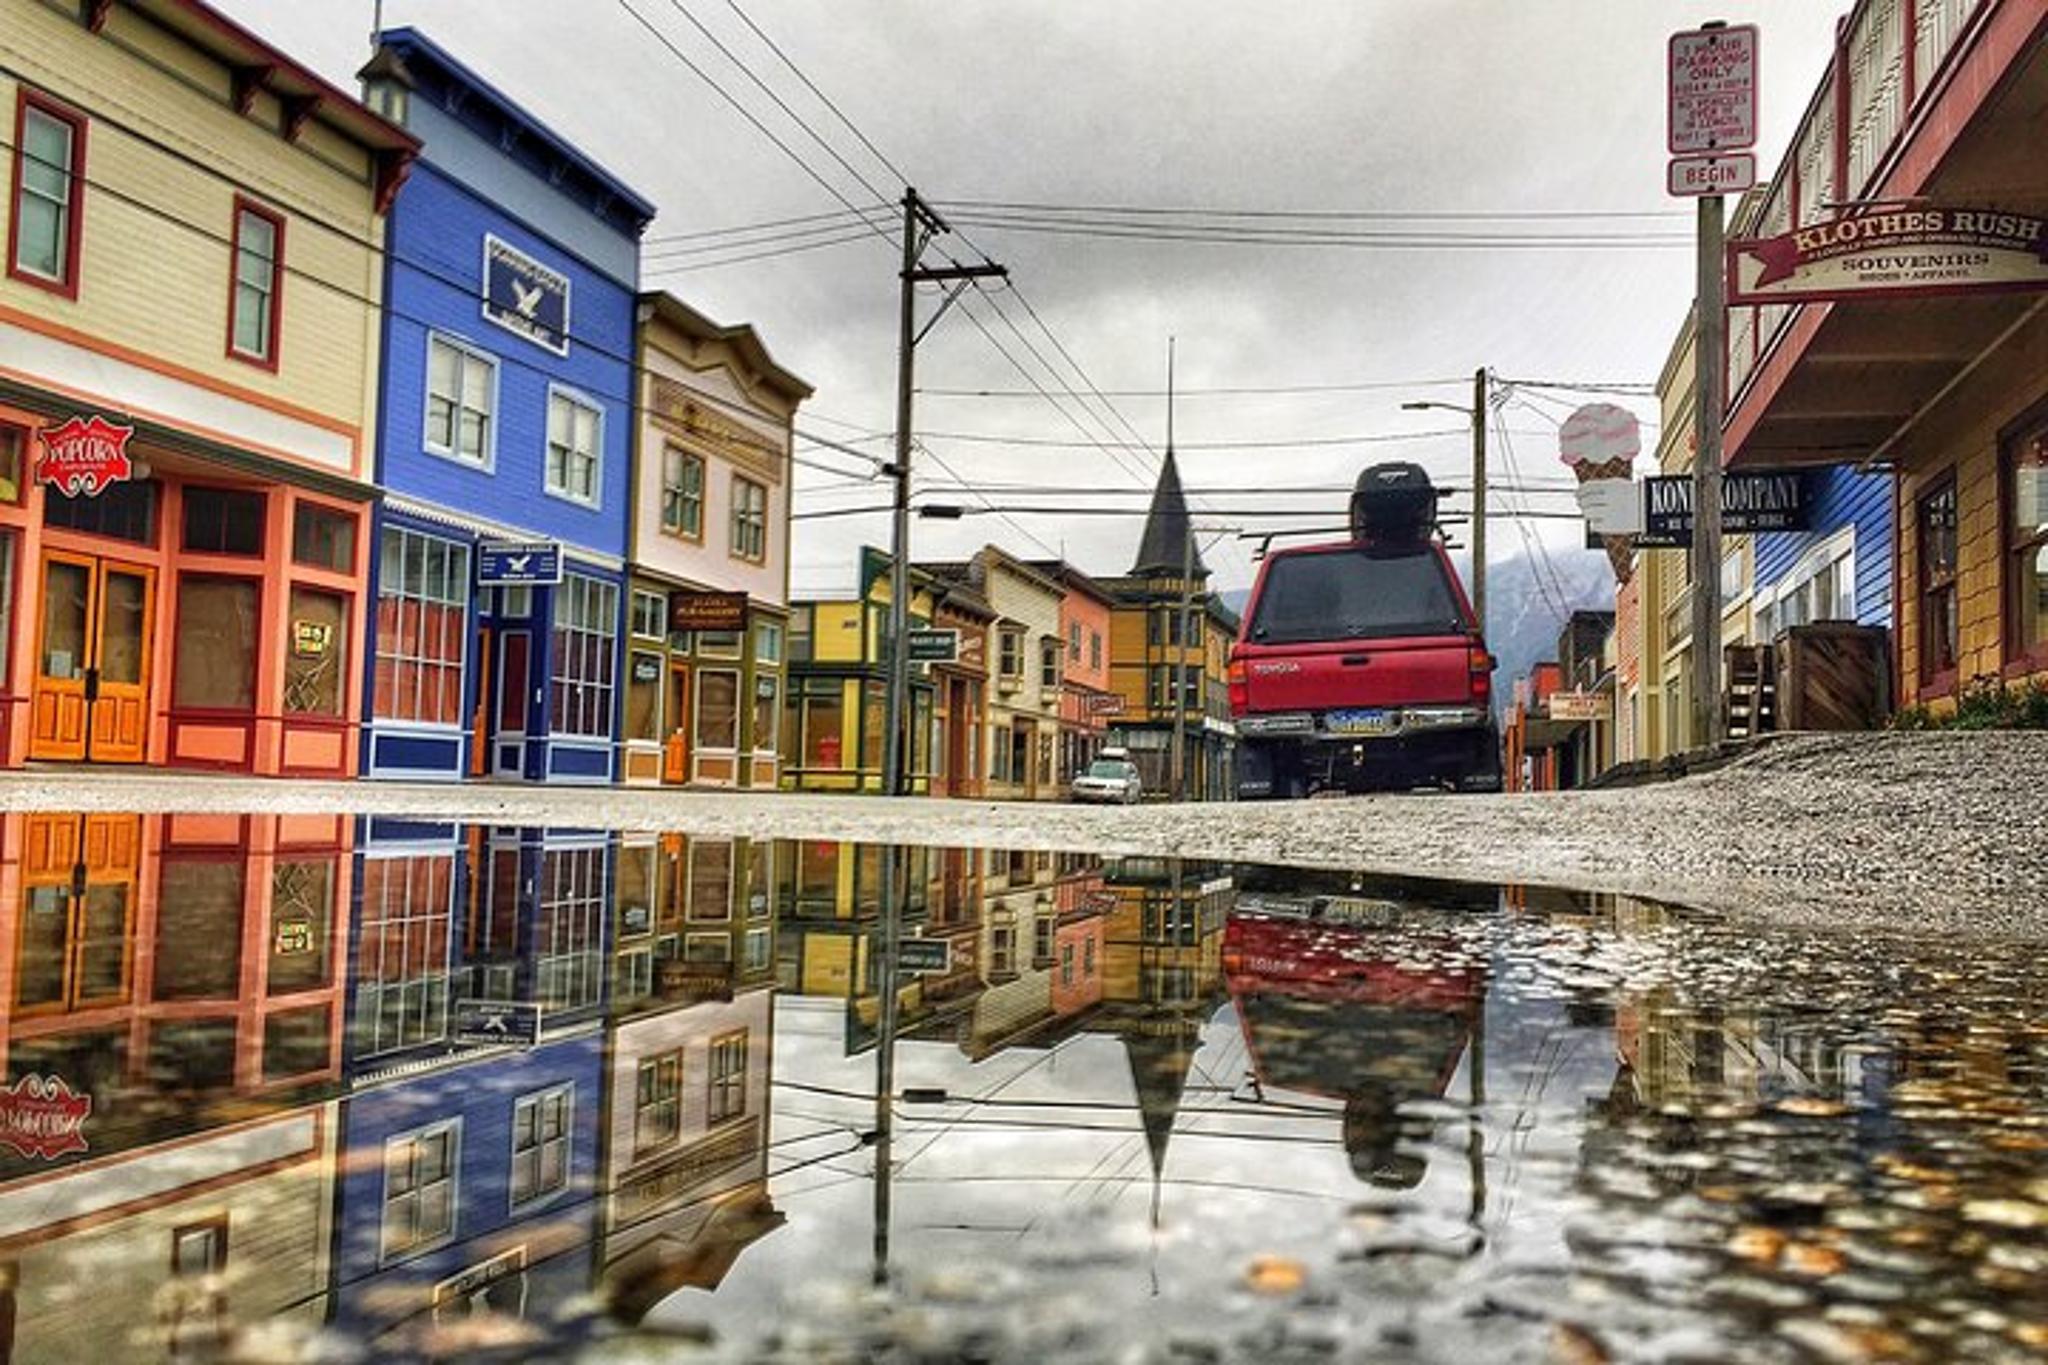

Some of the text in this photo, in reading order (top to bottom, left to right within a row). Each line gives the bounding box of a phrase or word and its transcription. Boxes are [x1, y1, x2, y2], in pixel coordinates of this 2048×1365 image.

[1695, 38, 1742, 55] HOUR
[1675, 48, 1750, 69] PARKING
[1689, 65, 1735, 81] ONLY
[1686, 166, 1737, 185] BEGIN
[1792, 210, 2042, 252] KLOTHES RUSH
[1842, 253, 1989, 271] SOUVENIRS
[50, 437, 118, 462] POPCORN
[1651, 474, 1799, 514] KON OMPANY
